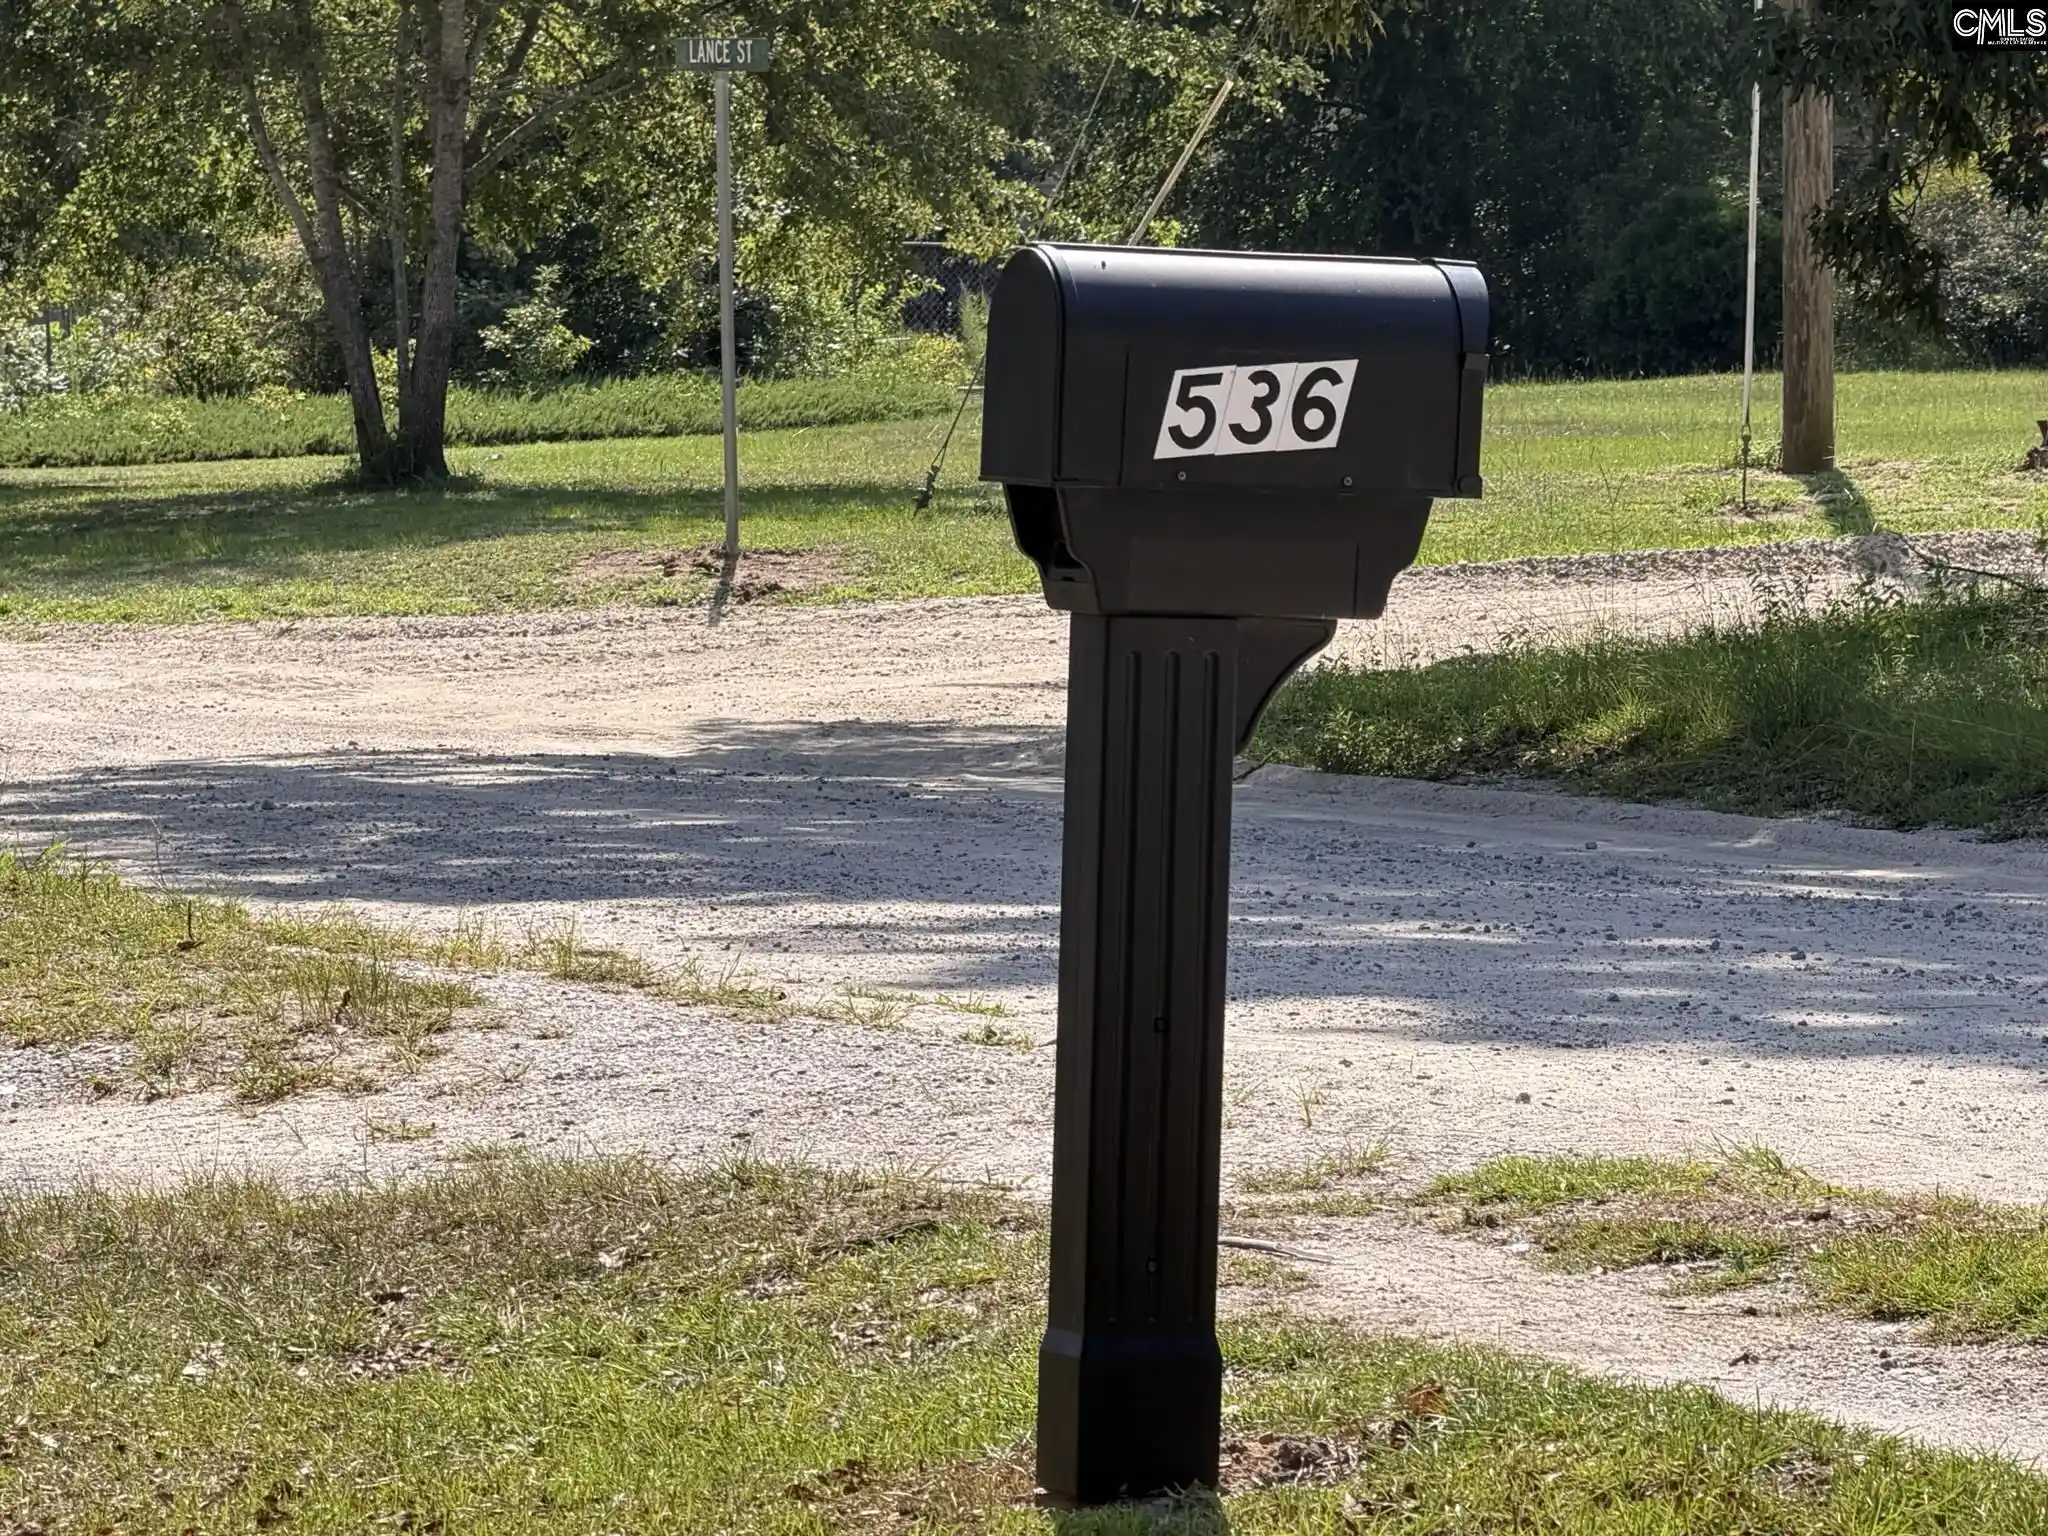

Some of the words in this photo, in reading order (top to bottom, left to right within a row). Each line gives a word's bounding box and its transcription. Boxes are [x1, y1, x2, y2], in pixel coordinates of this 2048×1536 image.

[689, 40, 731, 63] LANCE
[737, 40, 753, 63] ST
[1167, 366, 1344, 450] 536
